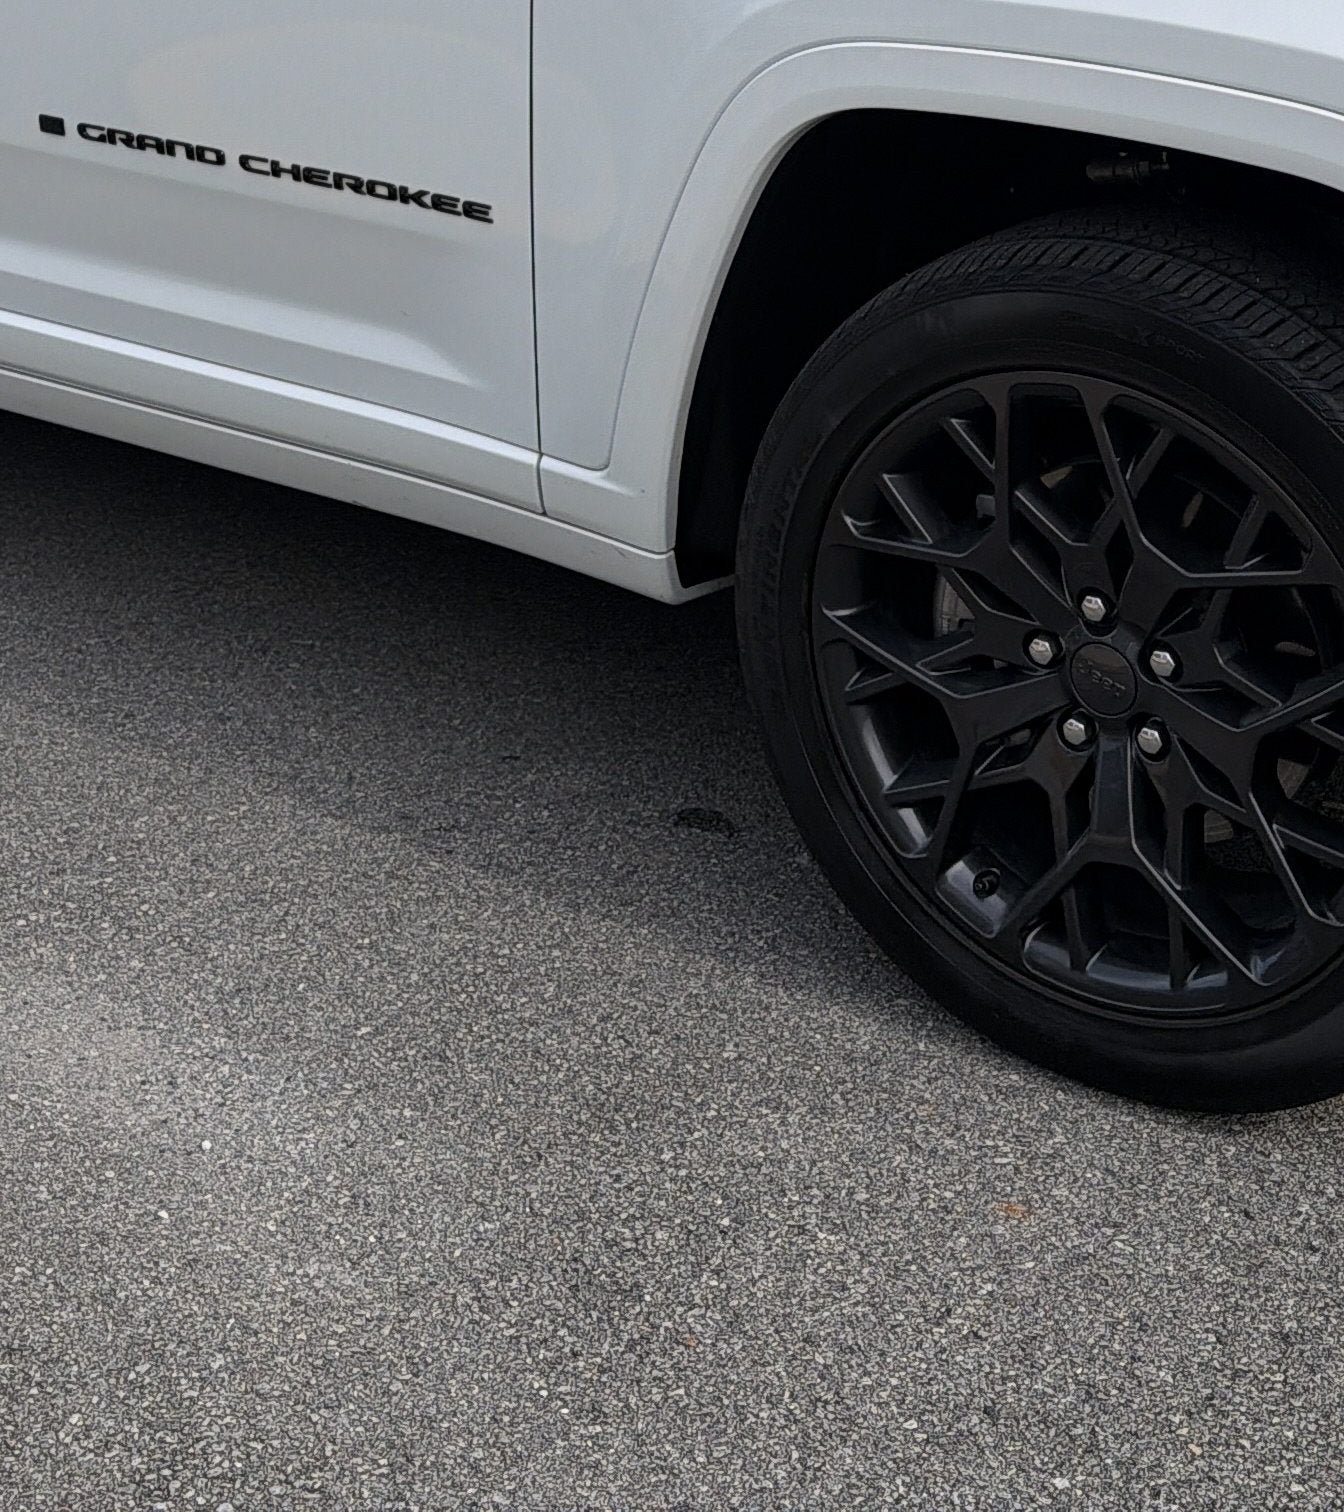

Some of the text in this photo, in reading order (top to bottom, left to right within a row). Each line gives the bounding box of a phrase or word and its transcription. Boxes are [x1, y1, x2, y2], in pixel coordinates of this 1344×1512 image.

[76, 121, 494, 224] GRAND CHEROKEE
[1078, 658, 1127, 697] Jeep
